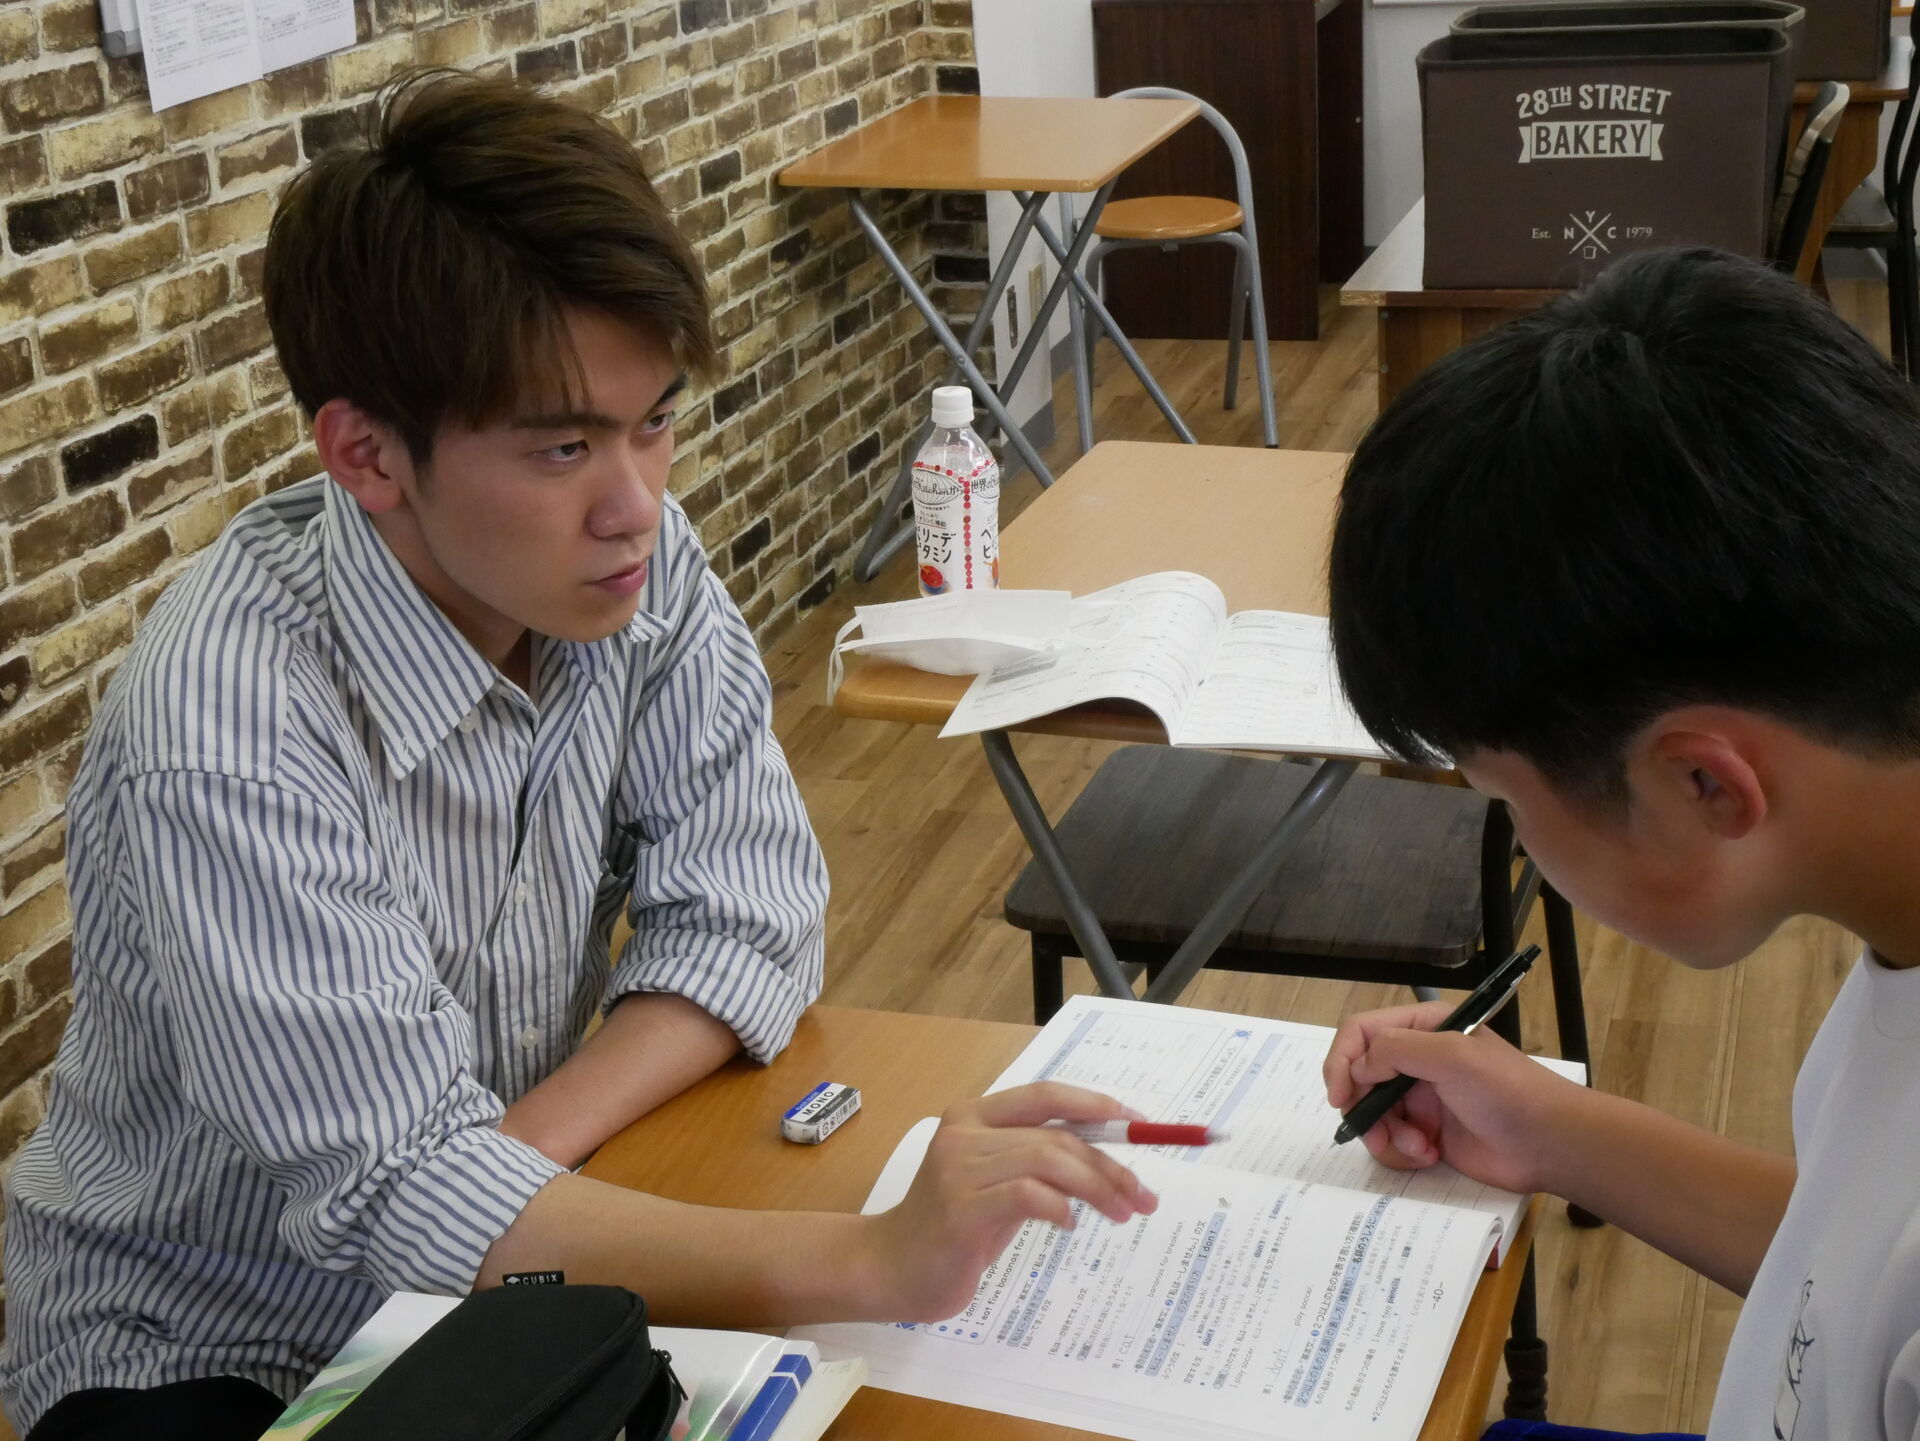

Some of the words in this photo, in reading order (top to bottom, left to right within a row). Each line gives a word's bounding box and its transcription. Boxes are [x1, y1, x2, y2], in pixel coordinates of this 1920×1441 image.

[1516, 86, 1572, 119] 28TH
[1579, 84, 1672, 115] STREET
[1535, 124, 1647, 155] BAKERY
[1531, 228, 1551, 239] Est.
[1626, 227, 1652, 238] 1979
[803, 1092, 834, 1116] MONO
[1021, 1228, 1030, 1236] a
[1012, 1235, 1026, 1252] for
[995, 1250, 1020, 1289] bananas
[1088, 1256, 1102, 1273] like
[522, 1274, 558, 1285] CUBIX
[985, 1286, 1002, 1306] five
[980, 1305, 993, 1321] eat
[975, 1319, 985, 1327] I
[1199, 1326, 1216, 1347] don't
